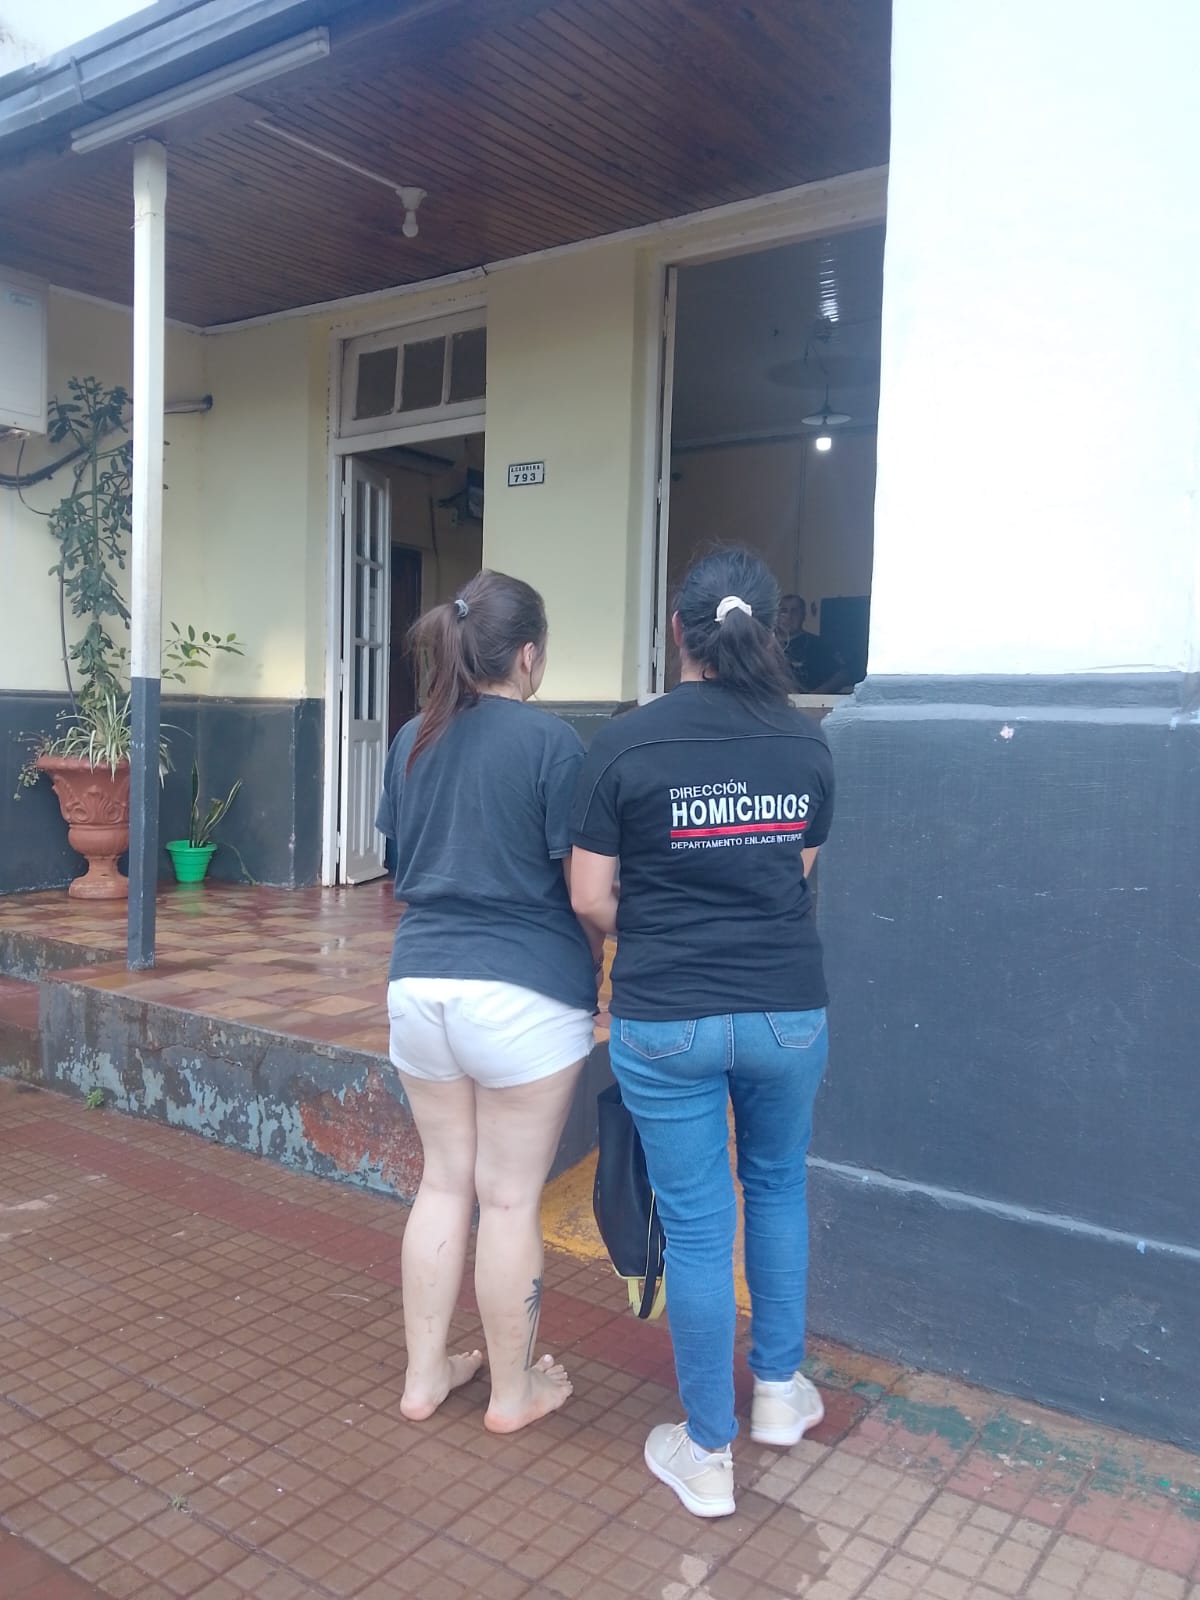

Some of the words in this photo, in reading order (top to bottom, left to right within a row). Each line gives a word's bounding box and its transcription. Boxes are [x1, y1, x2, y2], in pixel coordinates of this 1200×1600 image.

[514, 473, 536, 482] 793
[669, 779, 747, 800] DIRECCIÓN
[671, 794, 810, 827] HOMICIDIOS
[671, 838, 743, 849] DEPARTAMENTO
[744, 836, 776, 845] ENLACE
